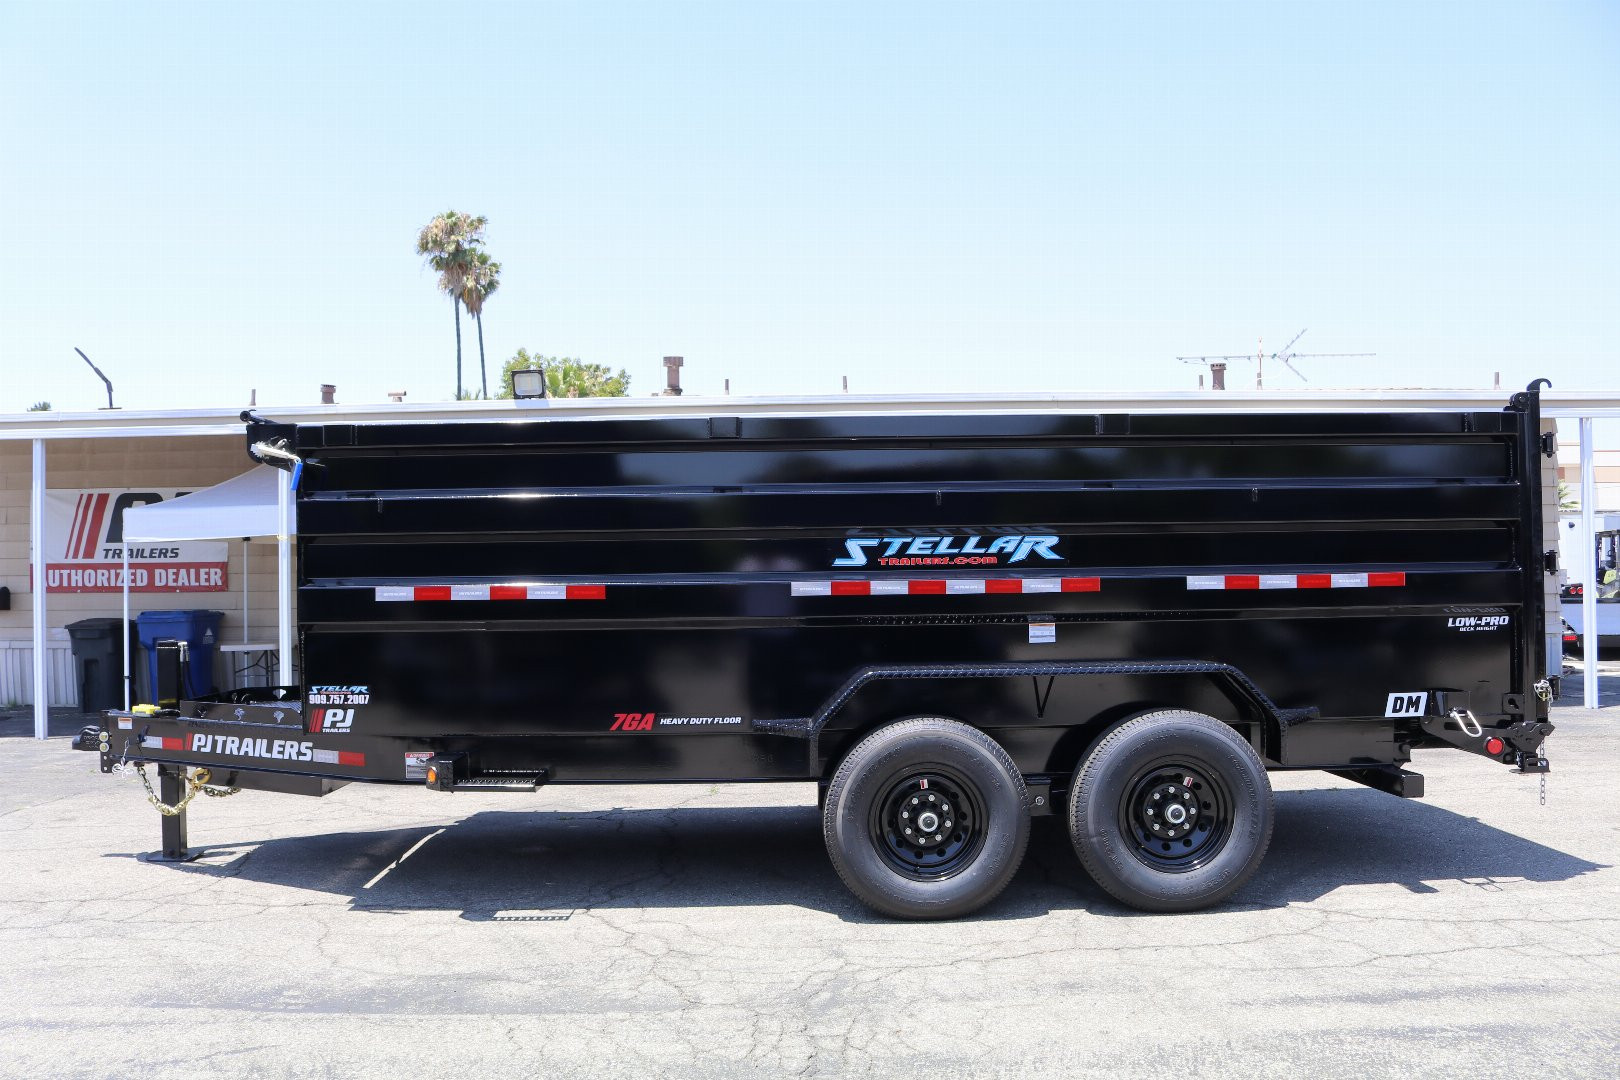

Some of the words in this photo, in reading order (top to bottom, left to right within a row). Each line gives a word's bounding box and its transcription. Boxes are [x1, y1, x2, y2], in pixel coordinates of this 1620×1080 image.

[103, 547, 180, 559] TRAILERS
[831, 535, 1065, 567] STELLAR
[878, 556, 998, 566] TRAILERS.COM
[45, 568, 148, 587] UTHORIZED
[154, 568, 223, 587] DEALER
[1447, 615, 1510, 627] LOW-PRO
[308, 685, 370, 694] STELLAR
[308, 694, 370, 705] 909.757.2007
[1391, 695, 1422, 714] DM
[323, 708, 355, 728] PJ
[609, 713, 656, 731] 7GA
[659, 717, 689, 725] HEAVY
[690, 717, 712, 725] DUTY
[713, 716, 742, 724] FLOOR
[191, 733, 213, 753] PJ
[214, 735, 314, 762] TRAILERS
